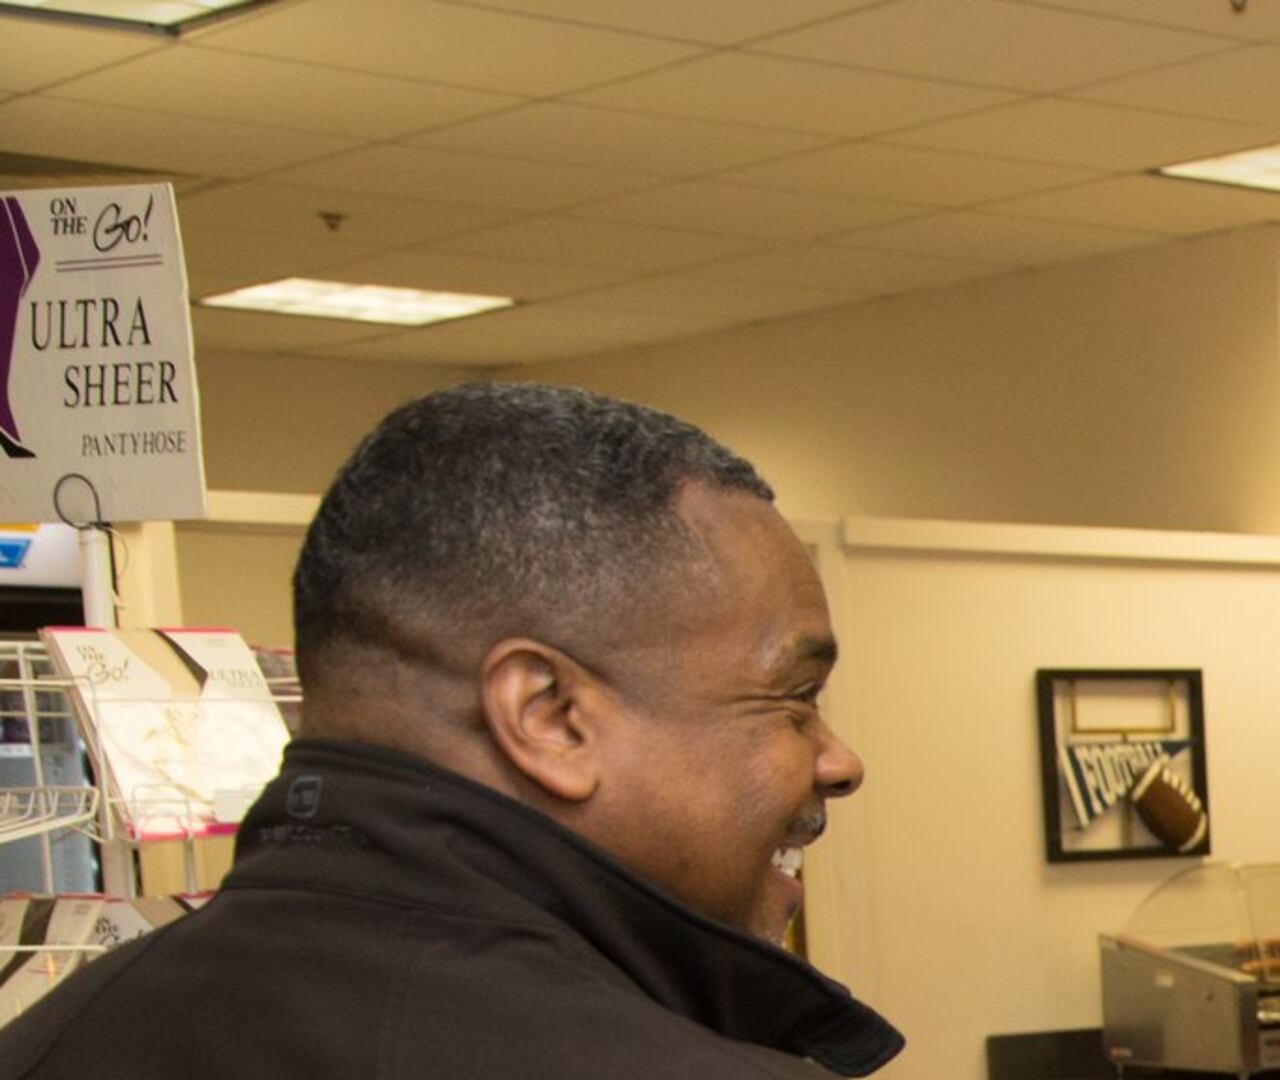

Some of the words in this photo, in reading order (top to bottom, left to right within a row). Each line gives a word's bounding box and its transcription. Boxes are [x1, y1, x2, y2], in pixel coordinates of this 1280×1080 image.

[50, 198, 77, 215] ON
[51, 217, 87, 235] THE
[93, 193, 154, 252] Go!
[30, 297, 153, 351] ULTRA
[63, 361, 179, 409] SHEER
[81, 430, 187, 457] PANTYHOSE
